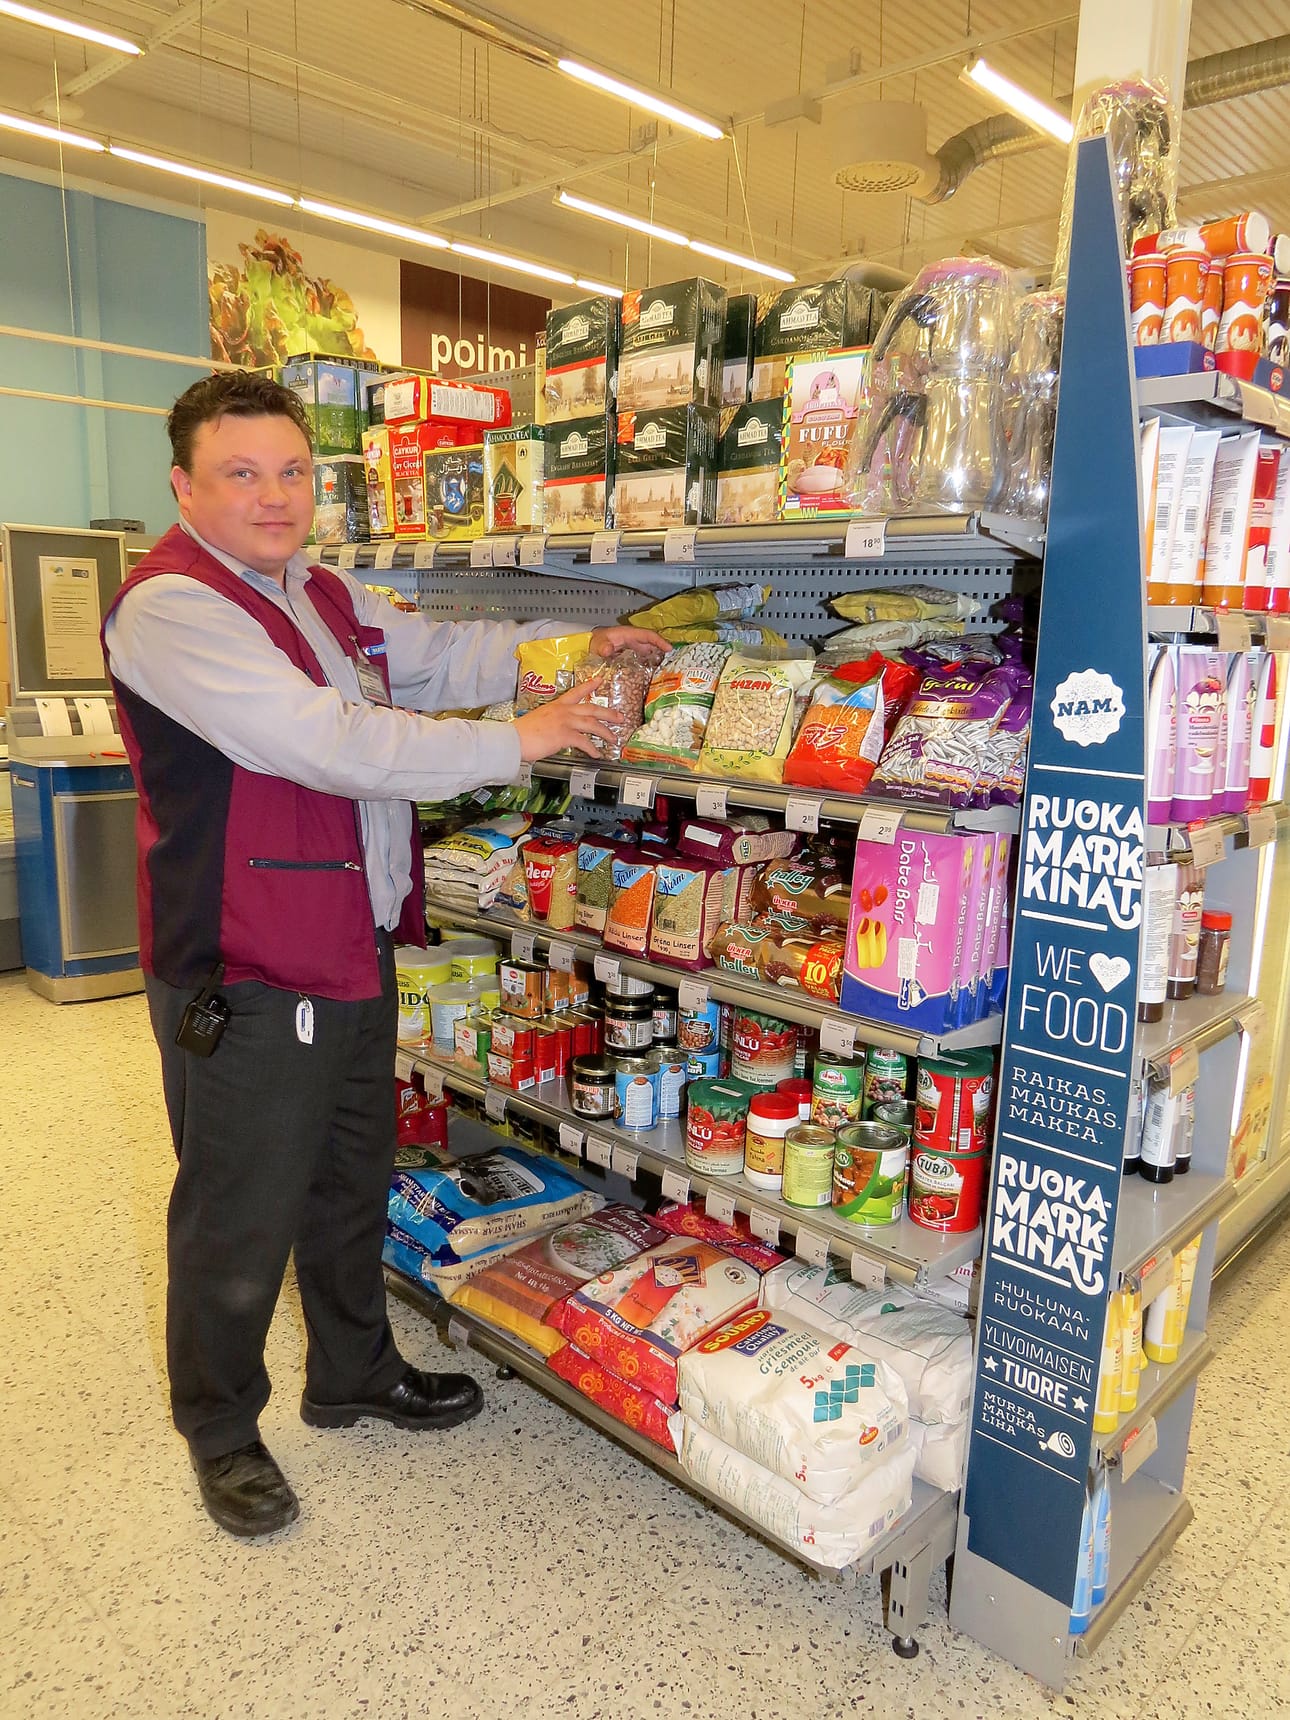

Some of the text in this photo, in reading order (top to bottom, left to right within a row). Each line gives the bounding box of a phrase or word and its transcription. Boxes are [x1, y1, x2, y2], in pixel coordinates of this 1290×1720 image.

[431, 333, 527, 373] poimi
[799, 424, 849, 443] FUFU
[1056, 698, 1118, 717] NAM.
[770, 868, 815, 889] halley
[894, 840, 915, 924] Date Bars
[1022, 863, 1143, 930] KINAT
[672, 939, 697, 951] Linser
[1036, 942, 1086, 985] WE
[720, 955, 761, 982] halley
[1020, 984, 1127, 1053] FOOD
[1012, 1066, 1111, 1106] RAIKAS.
[1008, 1104, 1104, 1144] MAKEA.
[1010, 1085, 1122, 1129] MAUKAS.
[919, 1157, 949, 1176] TUBA
[998, 1154, 1112, 1221] RUOKA-
[995, 1186, 1108, 1253] MARK-
[992, 1216, 1105, 1295] KINAT
[605, 1309, 613, 1317] 5
[705, 1311, 765, 1351] SOUBRY
[994, 1292, 1089, 1341] RUOKAAN
[736, 1324, 777, 1348] Catering
[746, 1329, 781, 1351] Quality
[759, 1331, 812, 1375] Griesmeel
[984, 1323, 1092, 1384] YLIVOIMAISEN
[774, 1339, 821, 1377] semoule
[1002, 1358, 1069, 1409] TUORE
[981, 1412, 1016, 1437] LIHA
[982, 1401, 1046, 1438] MAUKAS
[983, 1391, 1037, 1423] MUREA
